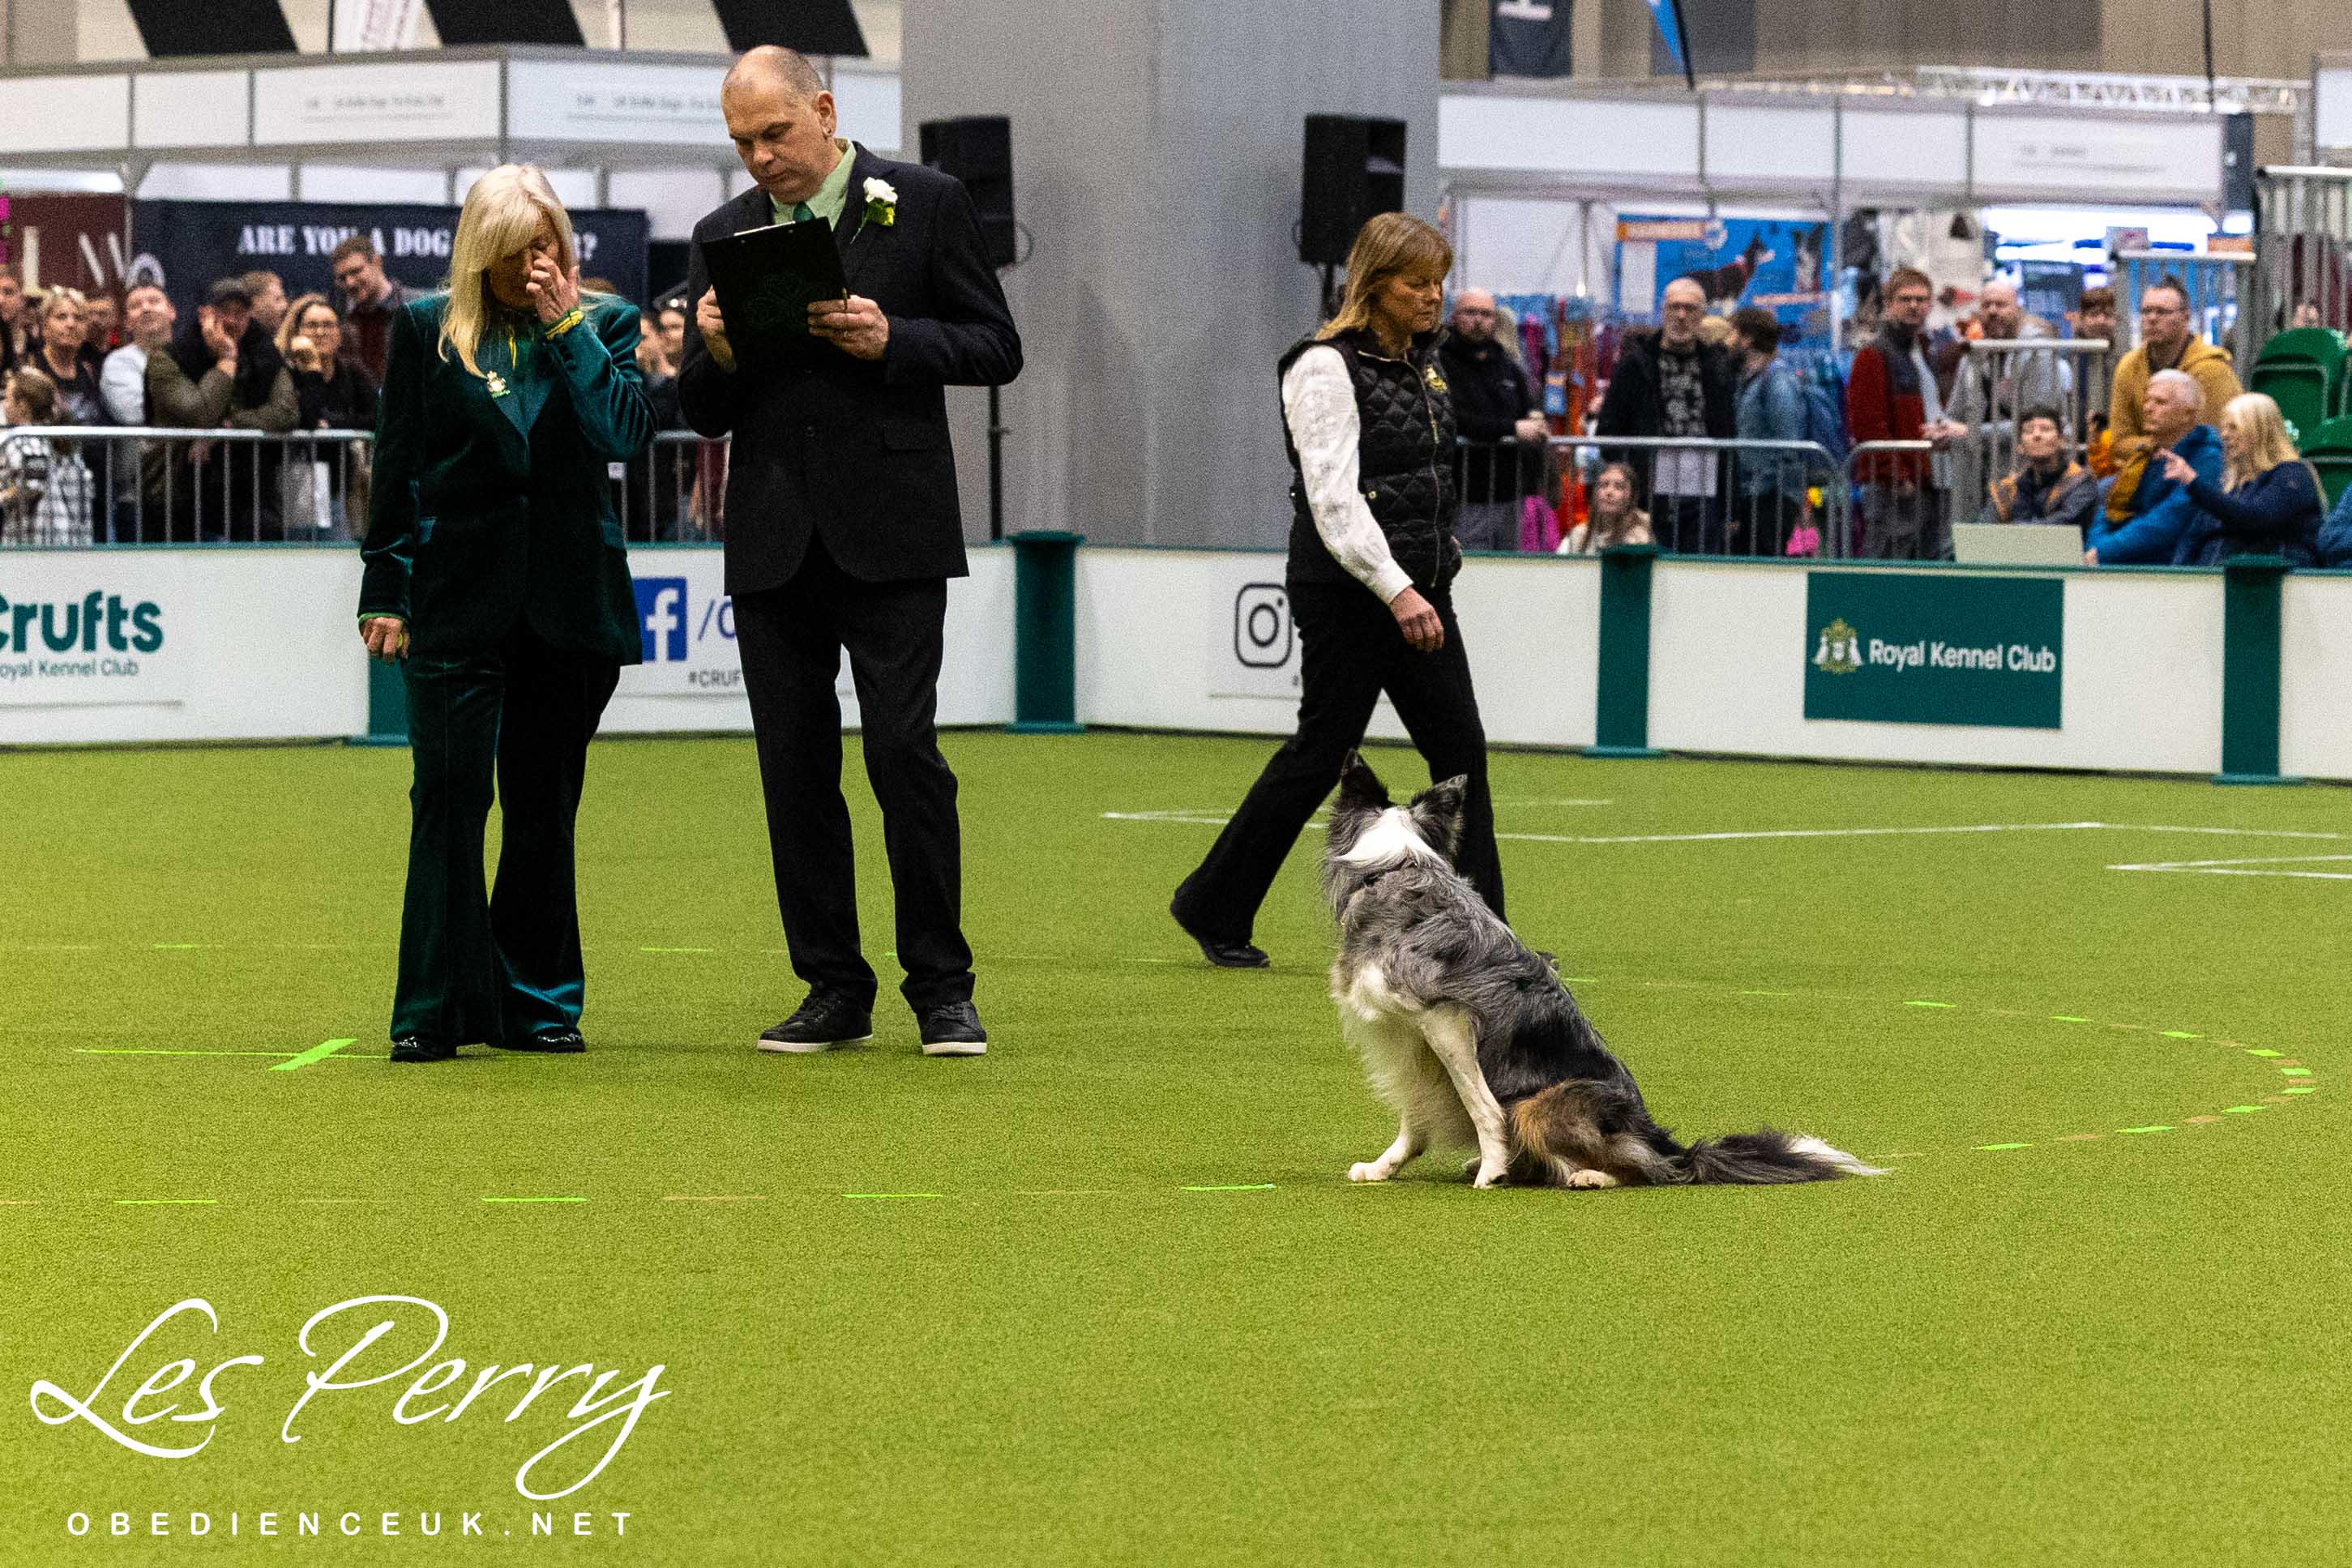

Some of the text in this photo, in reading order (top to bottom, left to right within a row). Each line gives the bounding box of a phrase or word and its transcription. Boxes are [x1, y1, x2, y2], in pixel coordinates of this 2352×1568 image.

[238, 224, 296, 254] ARE
[394, 227, 451, 257] DOG
[0, 658, 139, 681] oyal Kennel Club
[1868, 639, 2056, 673] Royal Kennel Club
[689, 669, 741, 686] #CRUF
